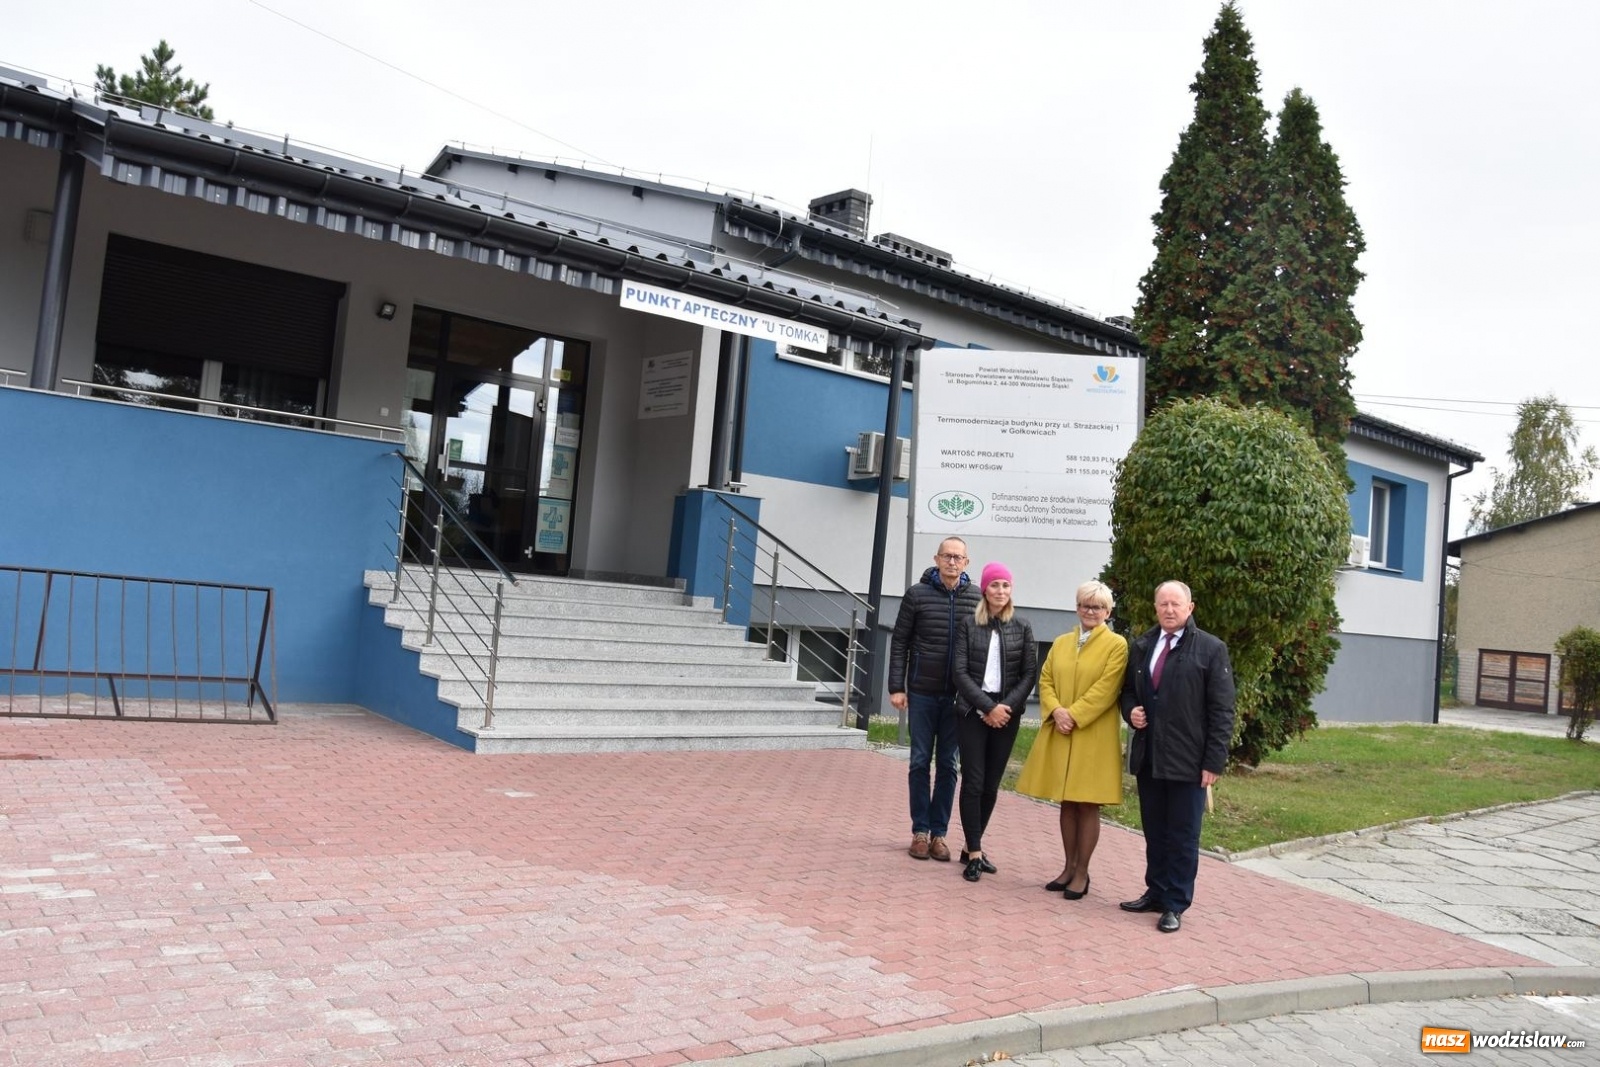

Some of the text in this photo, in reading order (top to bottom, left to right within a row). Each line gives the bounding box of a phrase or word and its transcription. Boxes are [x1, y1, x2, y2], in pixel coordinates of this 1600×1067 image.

[626, 287, 681, 310] PUNKT
[683, 302, 759, 329] APTECZNY
[945, 371, 975, 379] Starostwo
[938, 416, 1009, 426] Termomodernizacja
[1011, 420, 1043, 428] budynku
[1045, 421, 1061, 429] przy
[1074, 422, 1114, 432] Strażackiej
[978, 451, 1014, 459] PROJEKTU
[992, 493, 1039, 502] Dofinansowano
[1050, 495, 1075, 504] środków
[992, 504, 1087, 515] Funduszu Ochrony Środowiska
[995, 515, 1030, 524] Gospodarki
[1032, 516, 1055, 526] Wodnej
[1063, 518, 1098, 527] Katowicach
